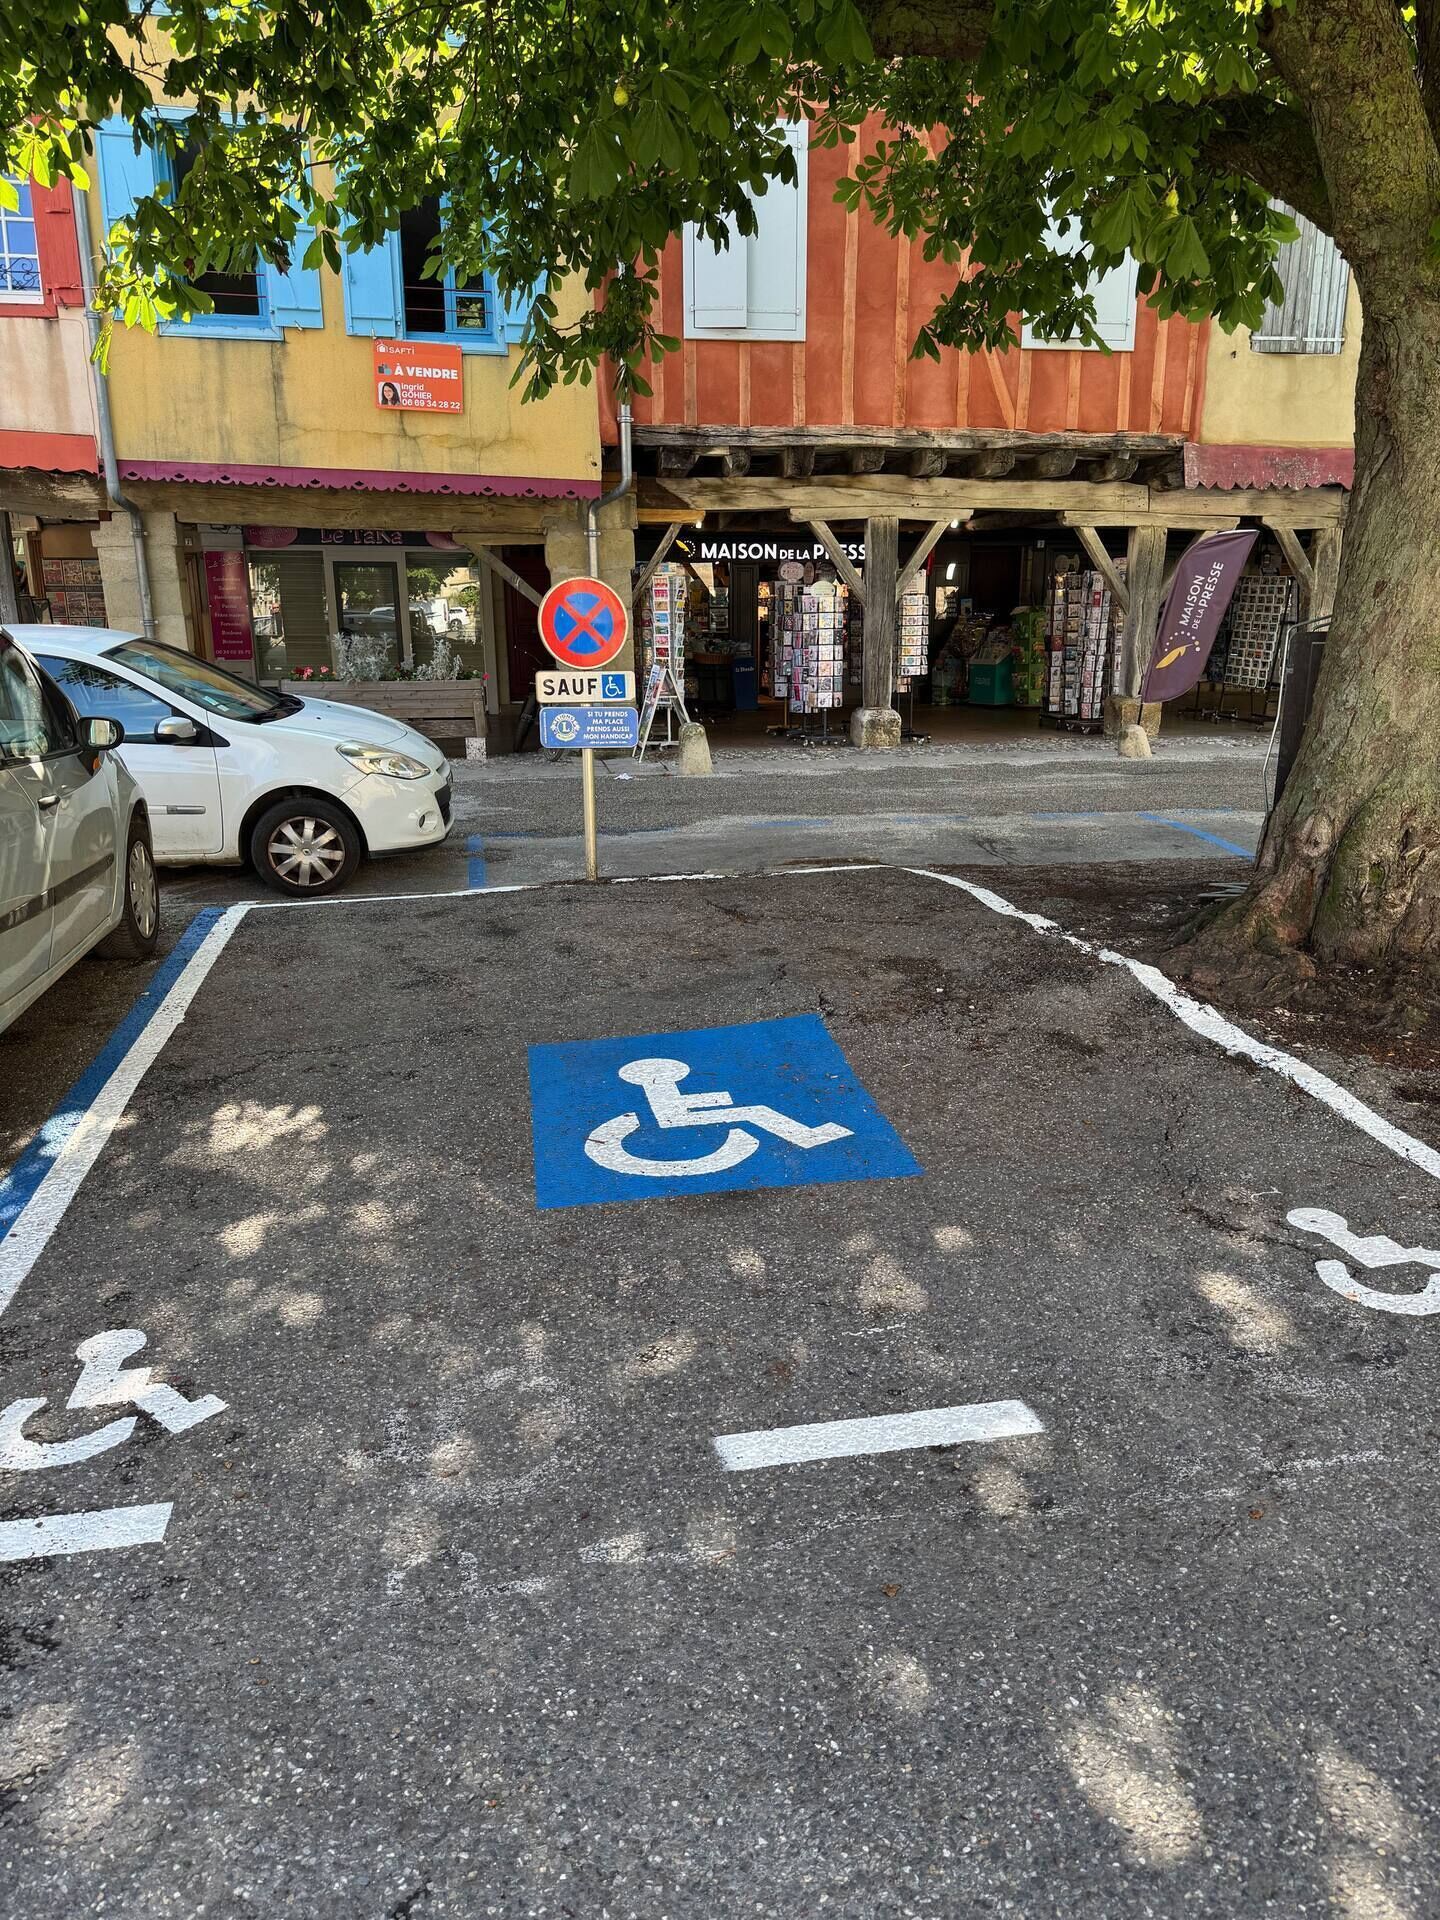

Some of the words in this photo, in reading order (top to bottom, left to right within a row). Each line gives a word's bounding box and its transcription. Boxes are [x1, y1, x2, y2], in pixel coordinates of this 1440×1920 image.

[394, 363, 404, 376] À
[406, 367, 458, 380] VENDRE
[401, 383, 425, 392] Ingrid
[401, 391, 432, 400] GOHIER
[402, 399, 413, 407] 06
[426, 400, 437, 408] 34
[438, 401, 449, 409] 28
[450, 402, 461, 410] 22
[320, 528, 345, 544] Le
[701, 543, 777, 559] MAISON
[779, 549, 795, 560] DE
[796, 549, 811, 560] LA
[813, 543, 866, 560] PSS
[1198, 561, 1225, 608] PRESSE
[1179, 575, 1205, 626] MAISON
[1197, 608, 1205, 619] LA
[1192, 618, 1201, 630] DE
[542, 678, 598, 696] SAUF
[562, 722, 571, 733] L
